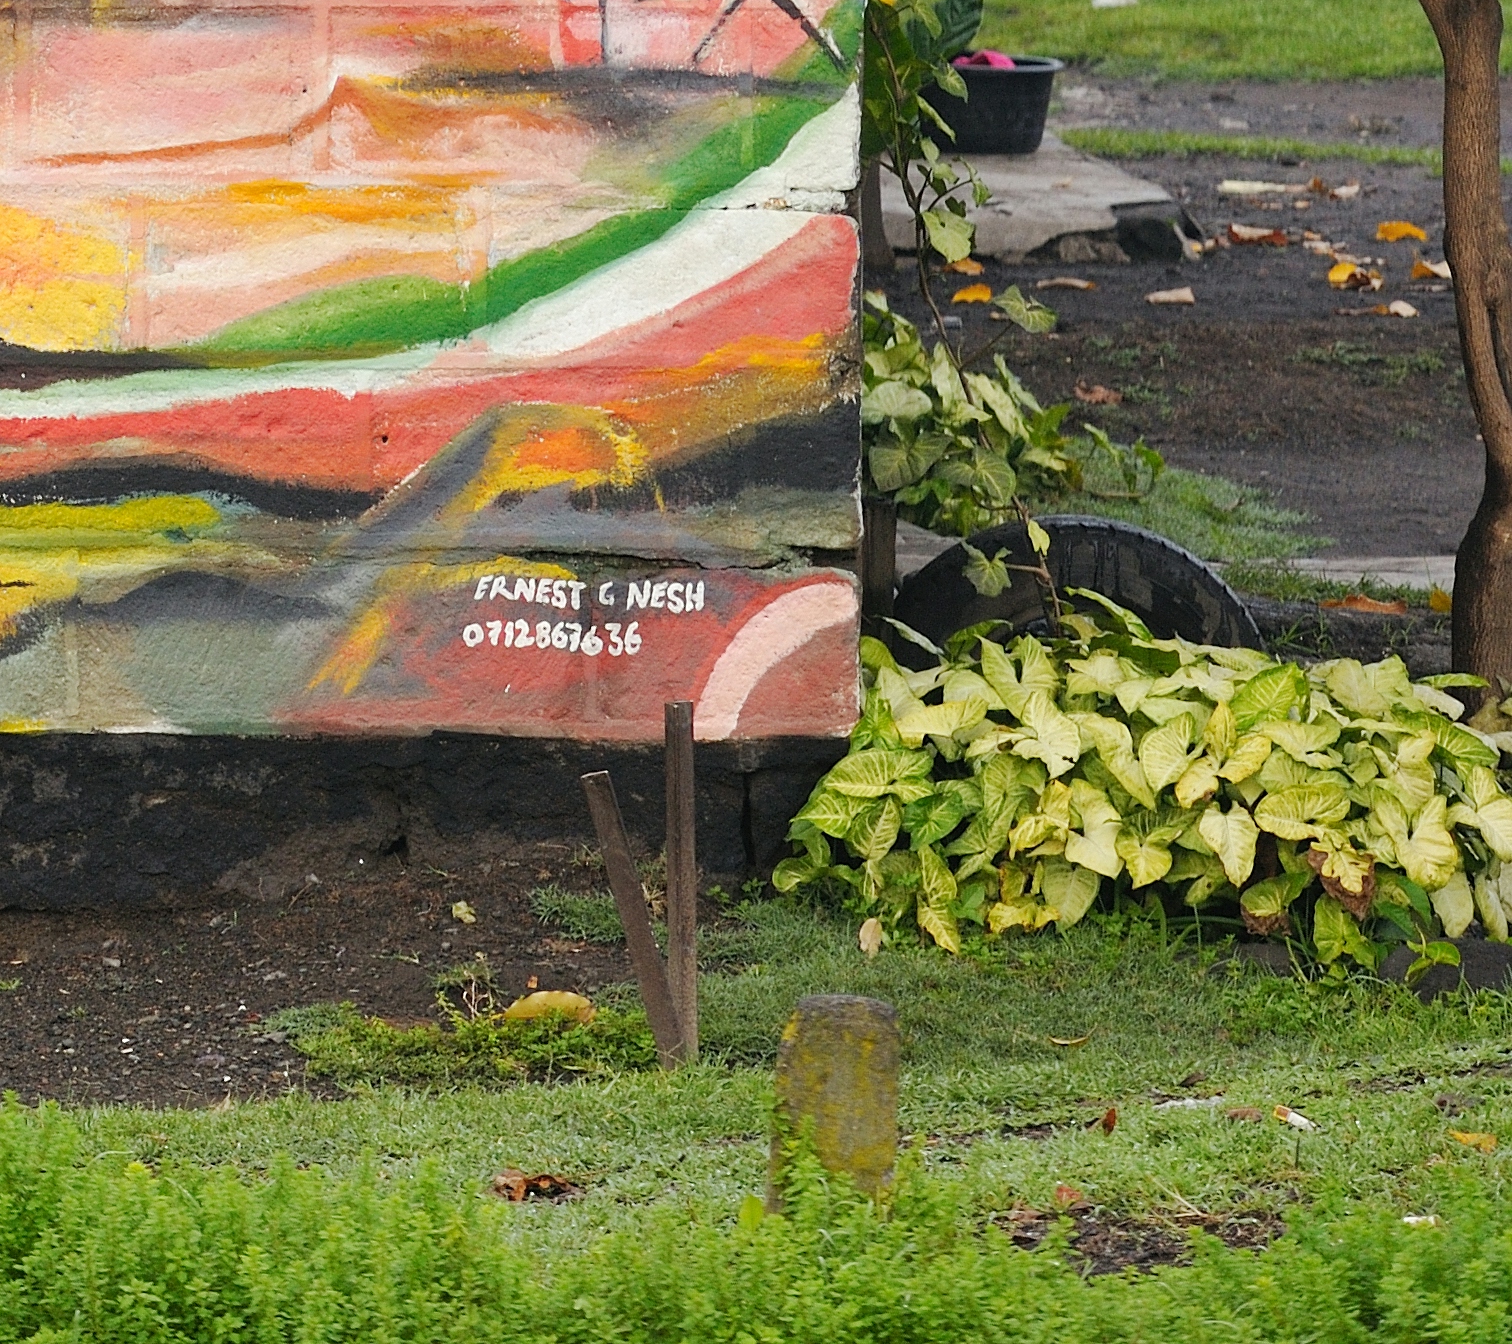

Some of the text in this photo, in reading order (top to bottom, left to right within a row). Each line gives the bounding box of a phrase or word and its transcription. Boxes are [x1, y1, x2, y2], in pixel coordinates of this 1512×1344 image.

[474, 575, 587, 610] ERNEST
[627, 580, 704, 614] NESH
[463, 619, 642, 656] 0712867636
